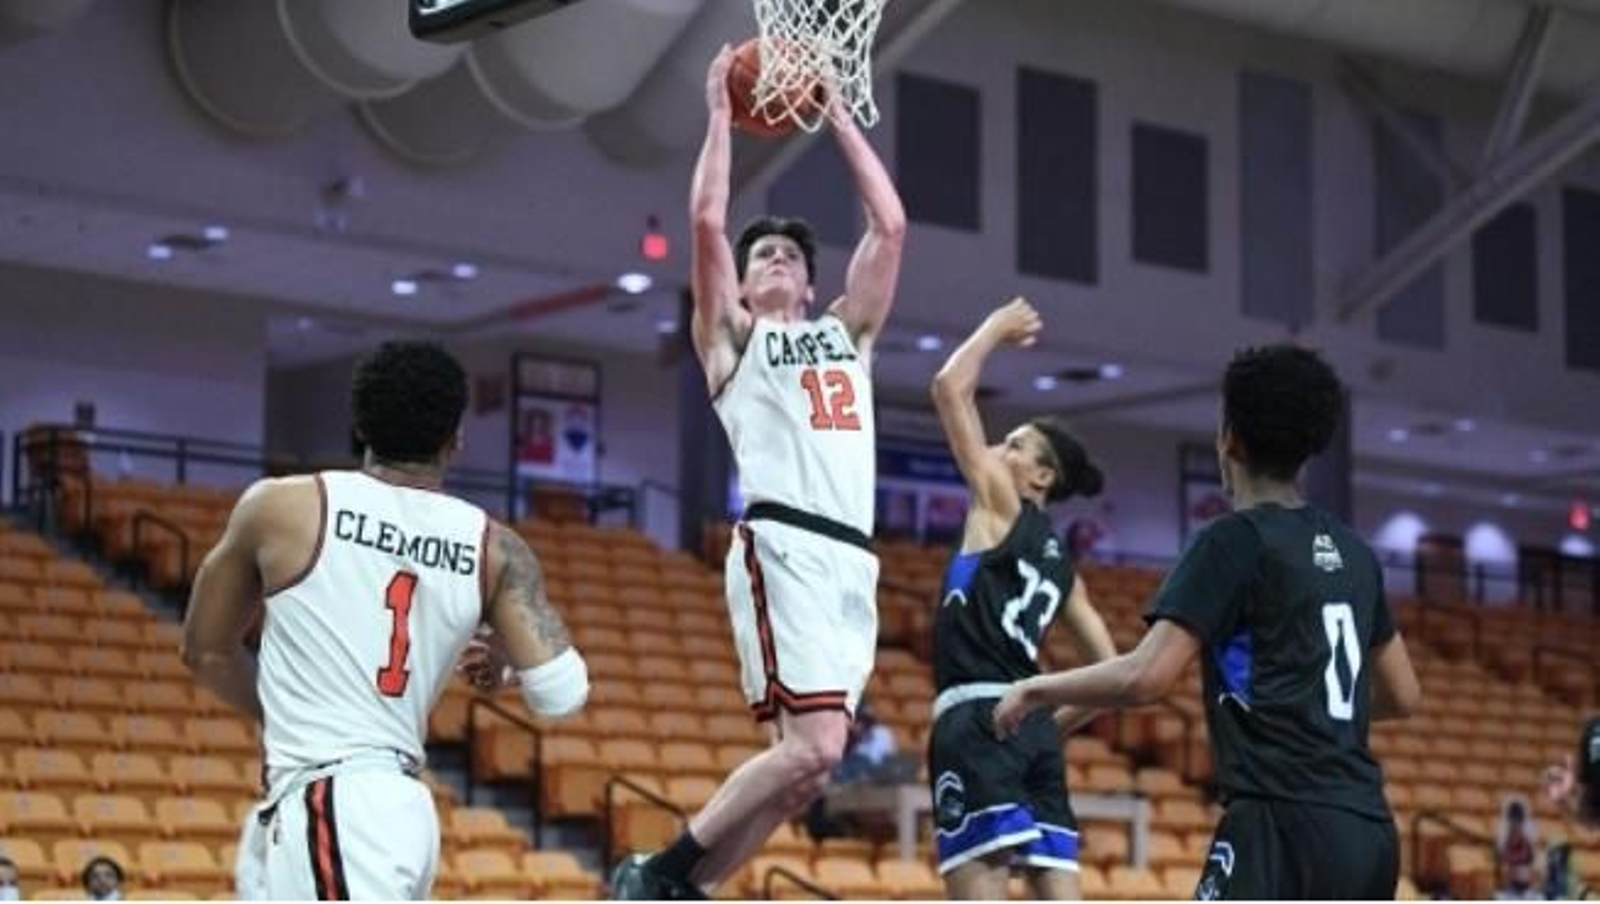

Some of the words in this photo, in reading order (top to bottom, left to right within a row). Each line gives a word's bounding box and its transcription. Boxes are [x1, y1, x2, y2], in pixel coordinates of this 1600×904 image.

[800, 368, 862, 431] 12
[335, 509, 476, 576] CLEMONS
[376, 569, 419, 698] 1
[1322, 603, 1362, 720] 0
